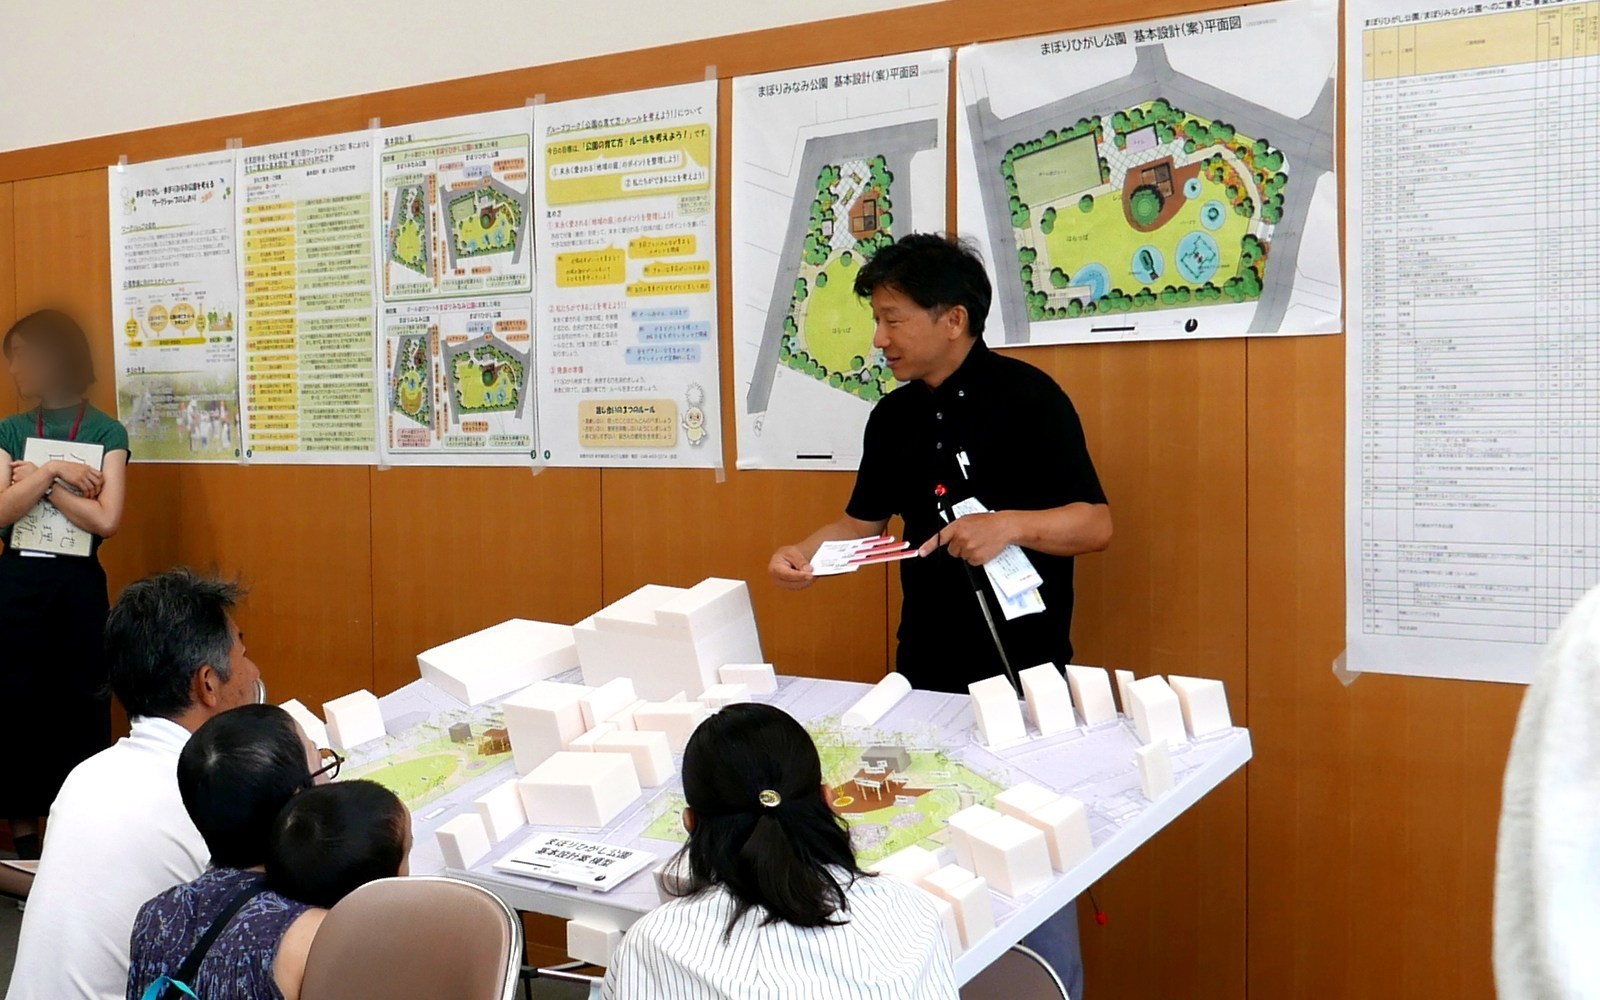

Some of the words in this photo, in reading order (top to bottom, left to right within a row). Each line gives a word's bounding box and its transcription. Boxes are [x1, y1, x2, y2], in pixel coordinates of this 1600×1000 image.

[1041, 31, 1127, 55] まぼりひがし公園
[1134, 15, 1242, 43] 基本設計(案)平面図
[757, 77, 828, 97] まぼりみなみ公園
[834, 65, 919, 88] 基本設計(案)平面図
[1066, 233, 1089, 242] はらっぱ
[534, 847, 592, 863] 基本設計案
[589, 857, 615, 867] 模型
[545, 837, 633, 859] まぼりひがし公園
